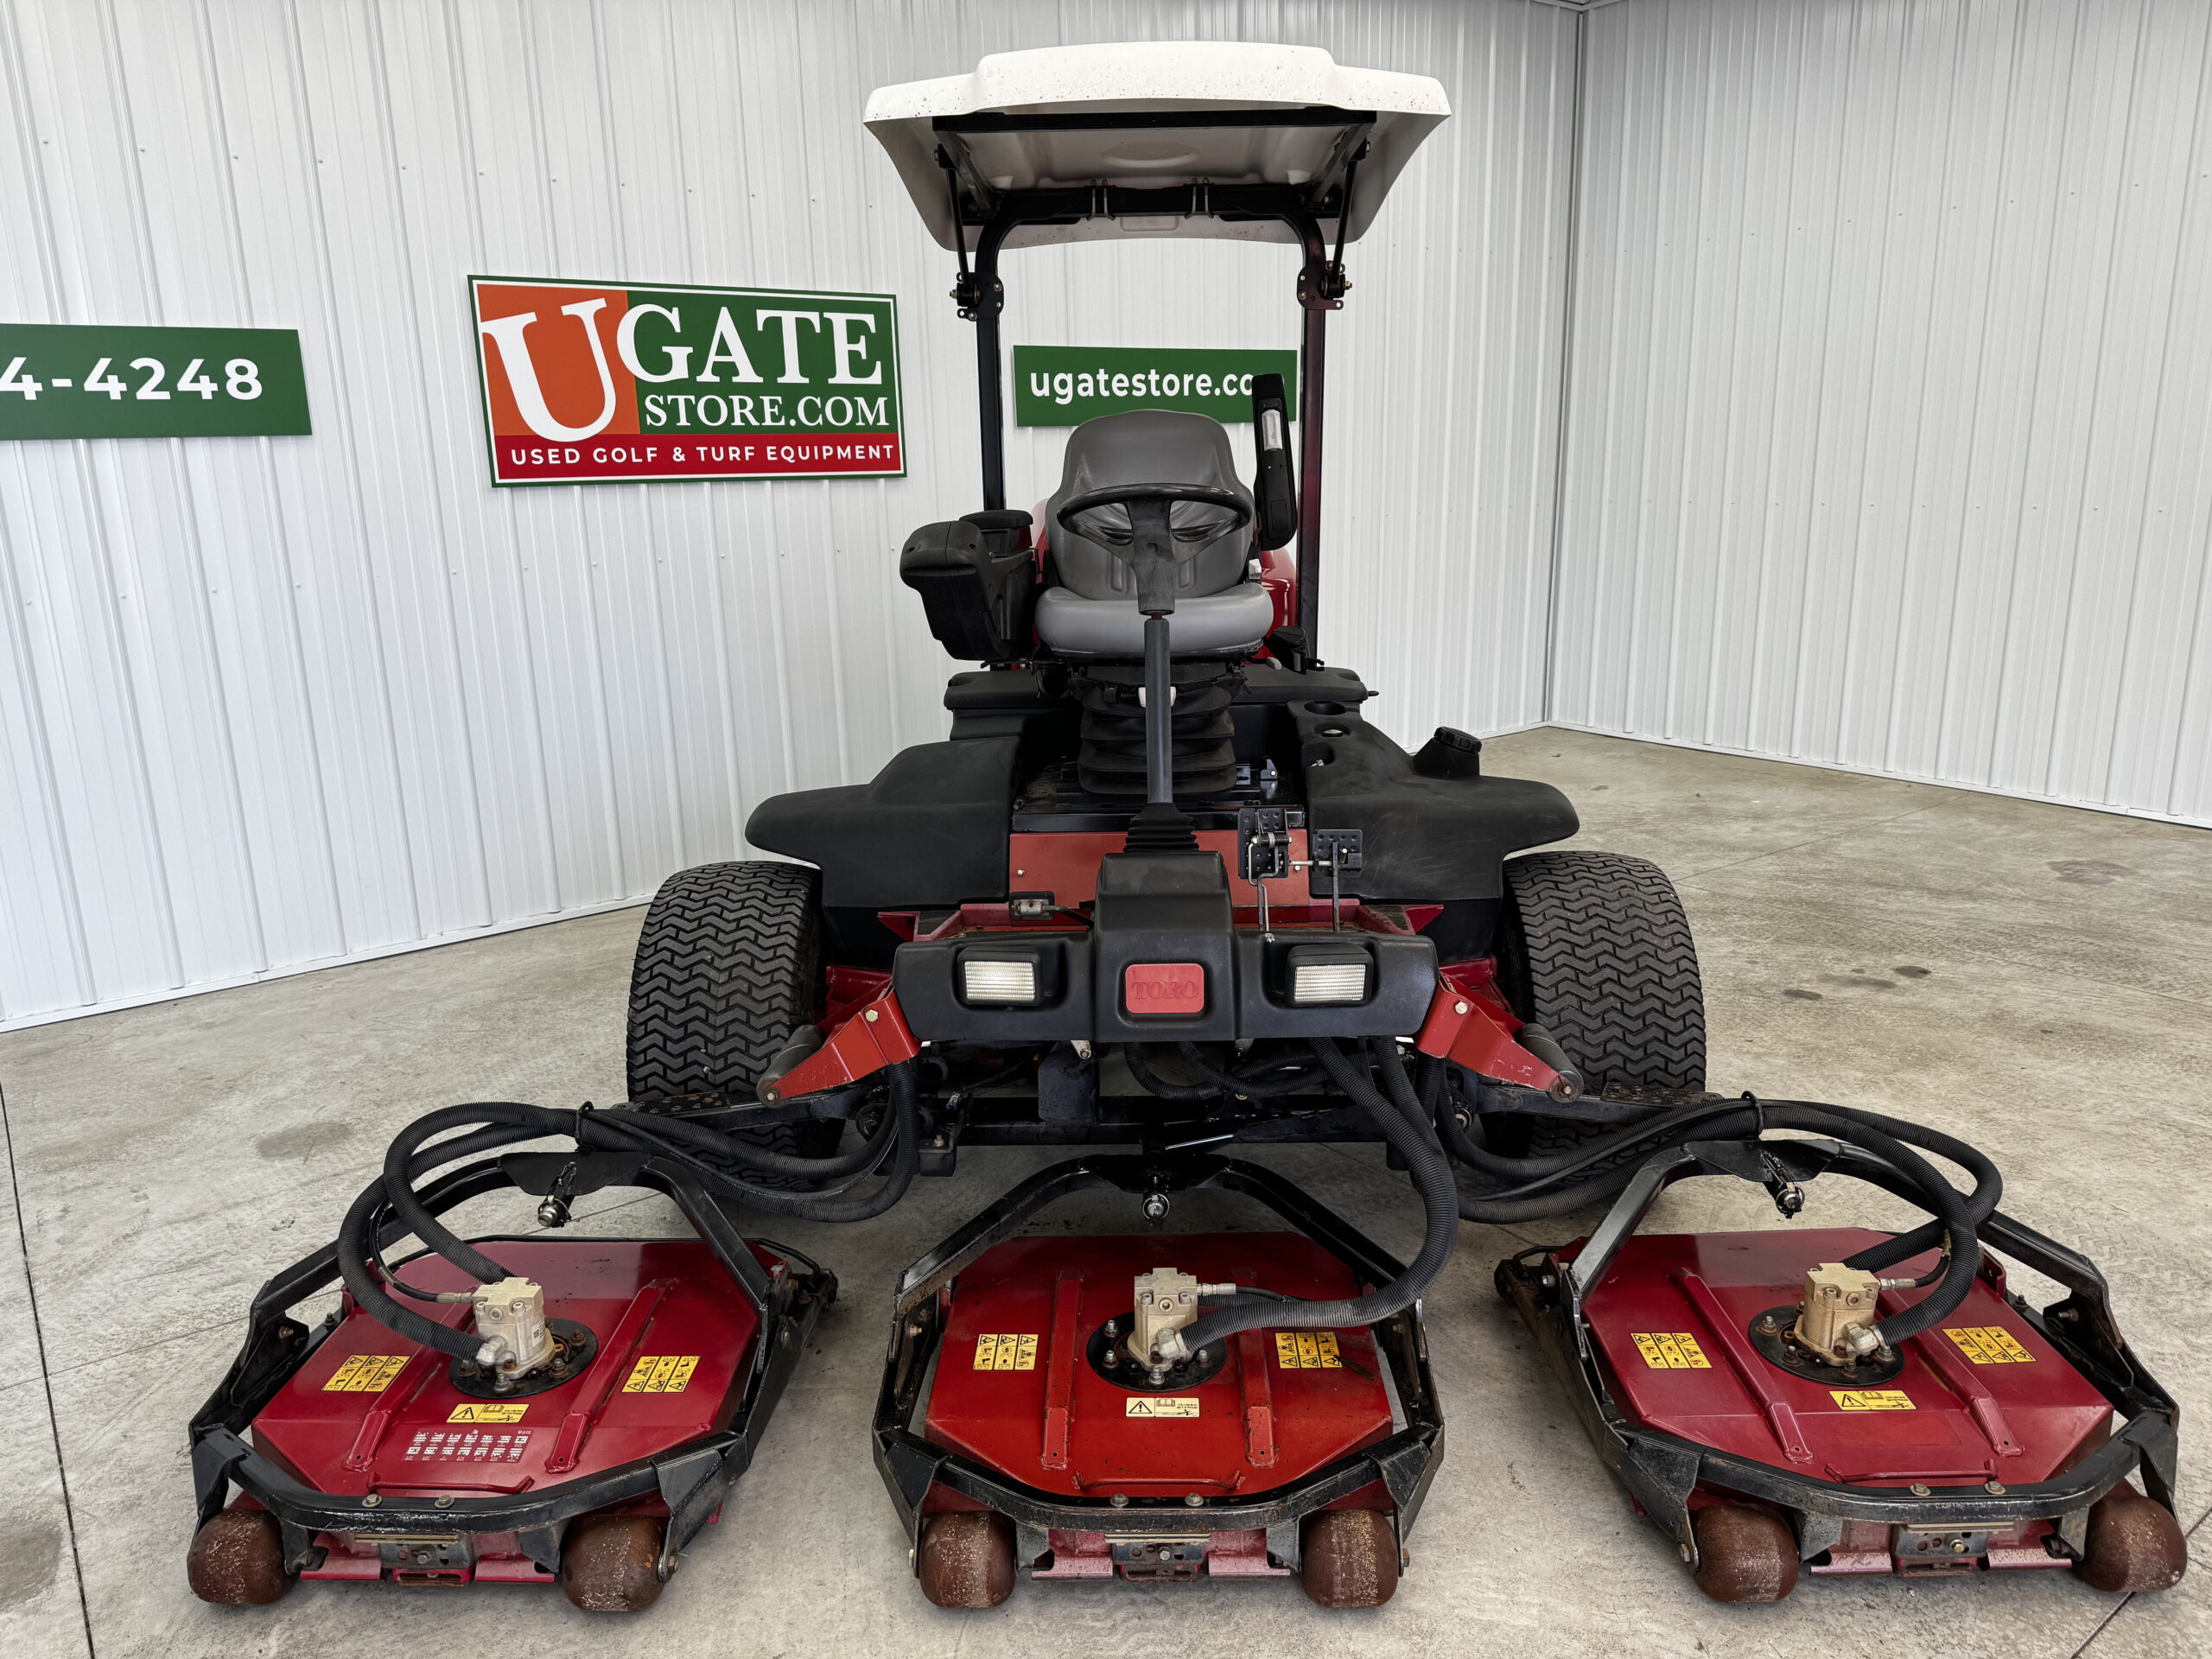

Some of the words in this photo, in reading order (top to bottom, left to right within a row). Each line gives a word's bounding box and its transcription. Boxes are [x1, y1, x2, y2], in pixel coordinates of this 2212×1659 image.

[0, 356, 263, 401] 4-4248
[1030, 368, 1255, 405] ugatestore.co
[645, 394, 890, 427] STORE.COM
[511, 448, 581, 466] USED
[593, 447, 658, 463] GOLF
[672, 447, 686, 462] &
[696, 446, 755, 461] TURF
[766, 444, 893, 463] EQUIPMENT
[1131, 980, 1199, 1000] TORO
